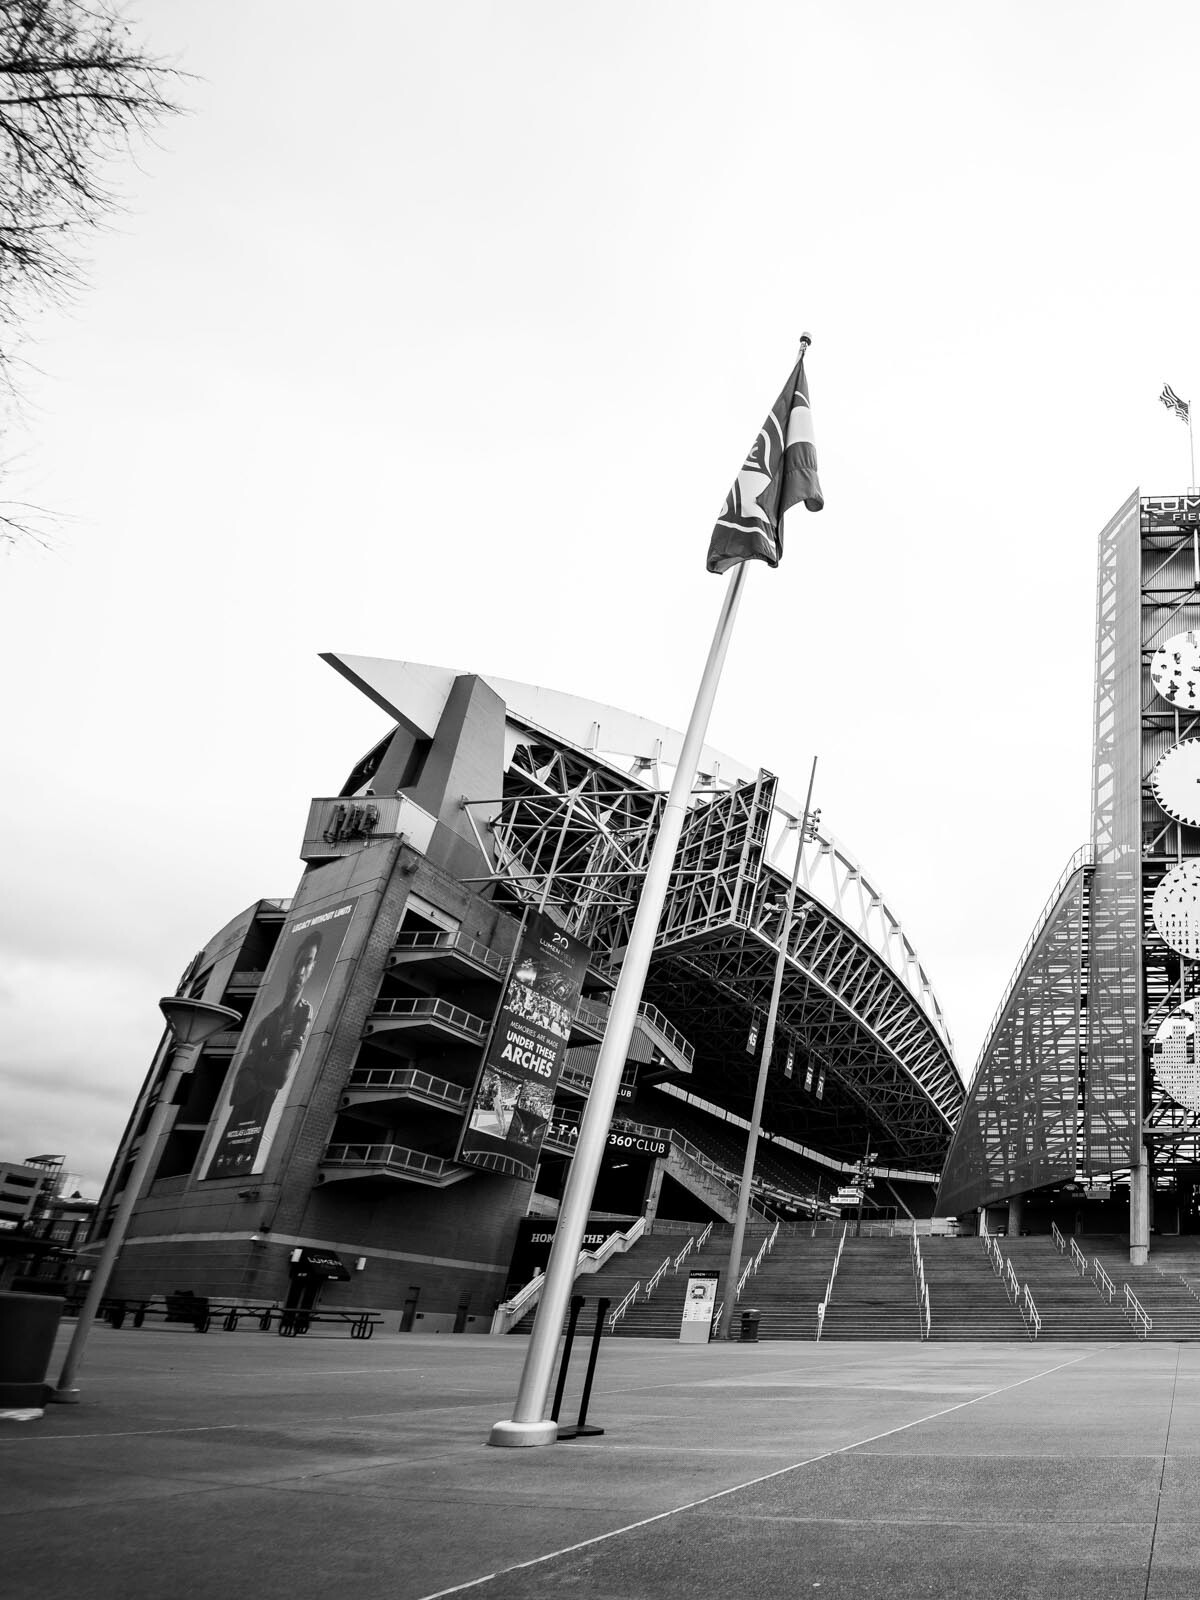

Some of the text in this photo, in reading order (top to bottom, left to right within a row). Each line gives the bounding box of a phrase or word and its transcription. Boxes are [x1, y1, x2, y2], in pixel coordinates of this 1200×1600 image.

[539, 937, 561, 955] LUMEN
[506, 1030, 557, 1062] UNDER THESE
[510, 1020, 559, 1049] MEMORIES ARE MADE
[500, 1043, 554, 1078] ARCHES
[547, 1121, 579, 1137] LTA
[636, 1139, 665, 1153] CLUB
[531, 1233, 604, 1244] HOM THE
[306, 1256, 343, 1267] LUMEN
